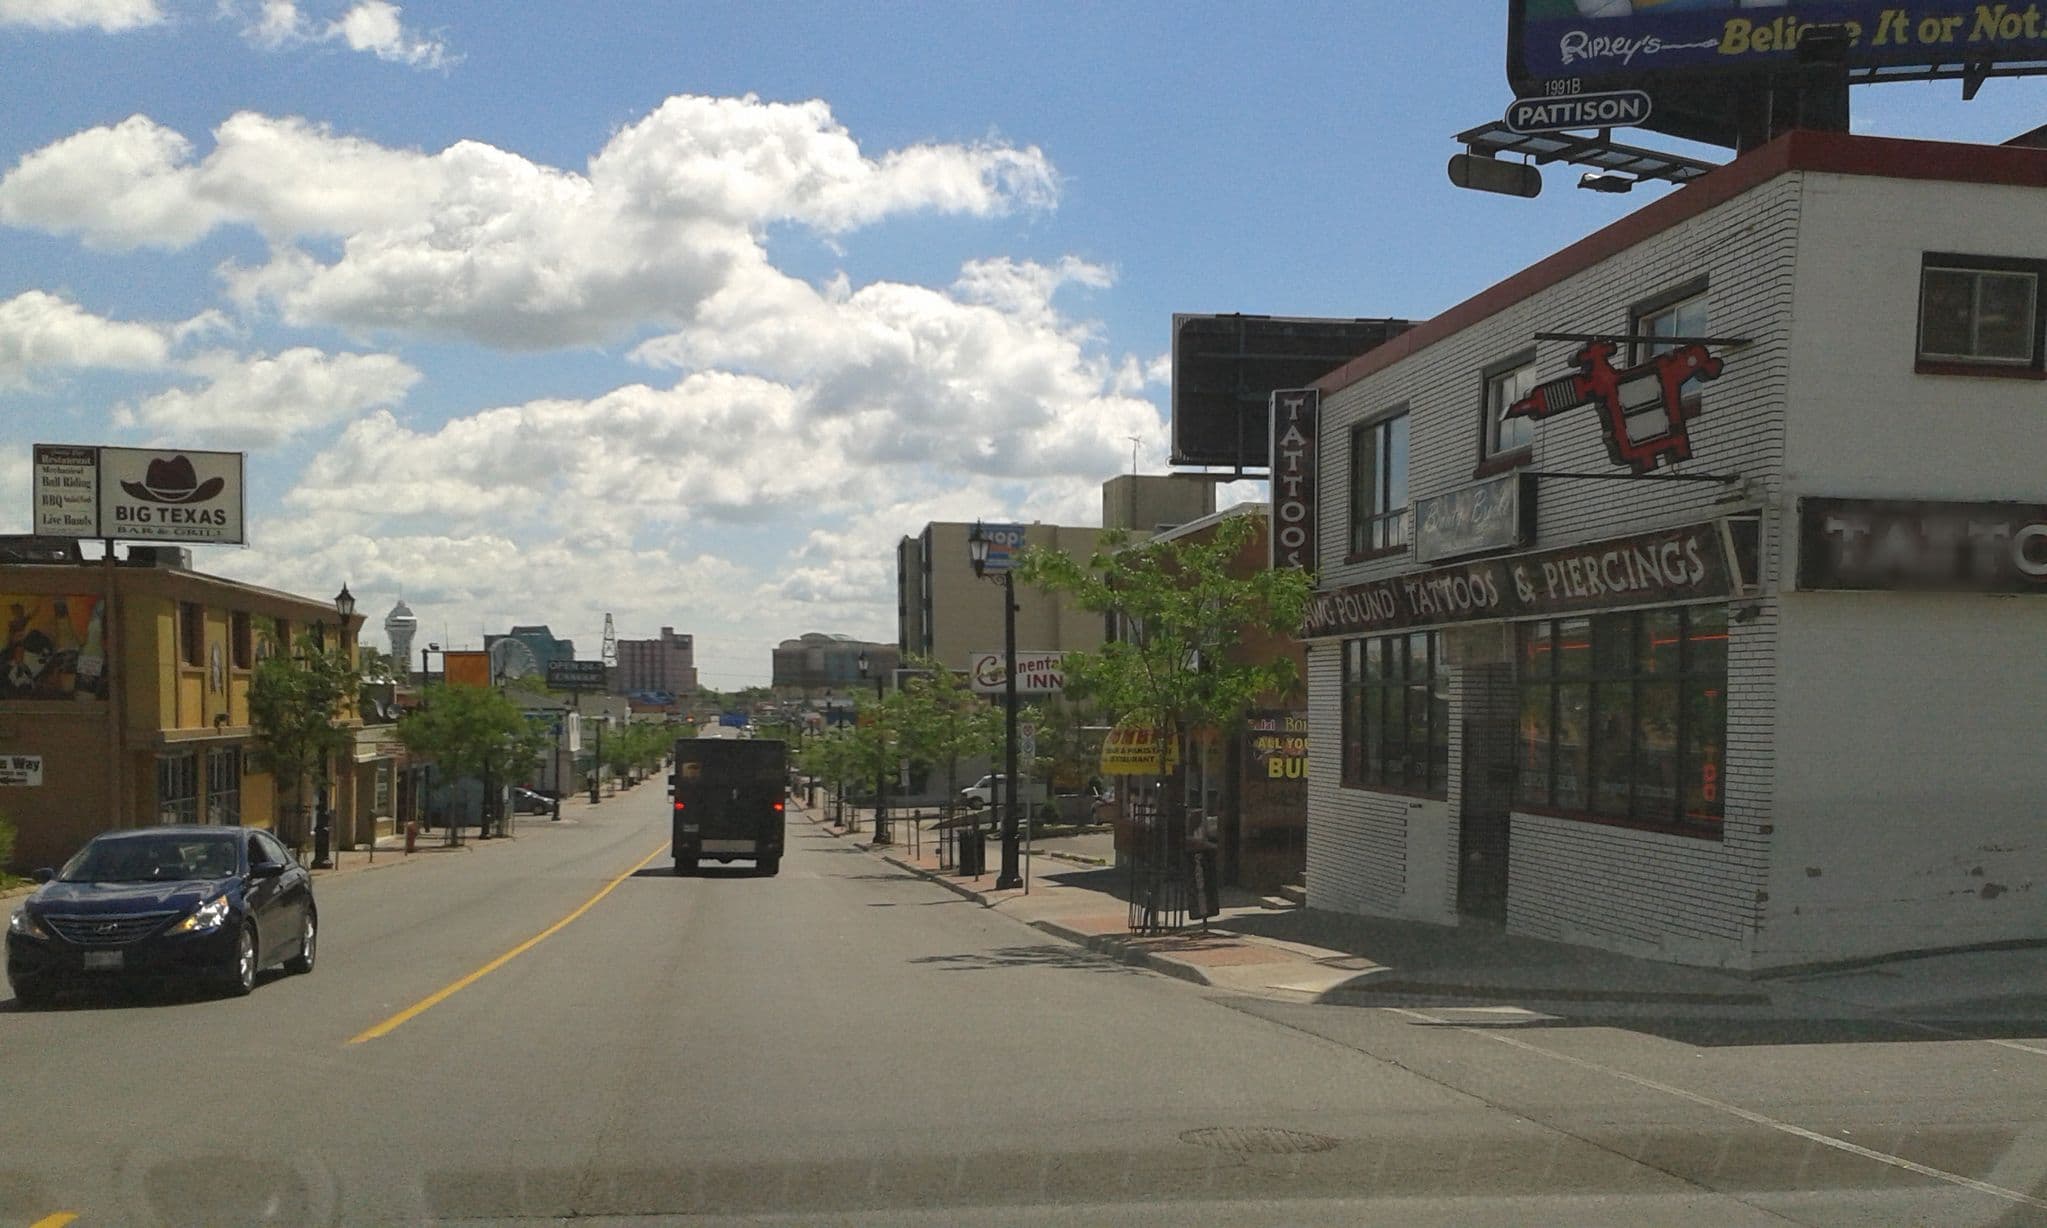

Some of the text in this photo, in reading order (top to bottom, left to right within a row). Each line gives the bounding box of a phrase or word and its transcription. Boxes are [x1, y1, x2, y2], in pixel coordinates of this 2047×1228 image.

[1718, 16, 1863, 55] Belie
[1872, 9, 1911, 46] It
[1917, 16, 1964, 45] or
[1544, 78, 1581, 96] 1991B
[1517, 99, 1640, 127] PATTISON
[1280, 398, 1307, 571] TATTOOS
[42, 495, 63, 508] BBQ
[115, 506, 226, 525] BIG TEXAS
[117, 526, 154, 534] BAR
[1299, 535, 1705, 630] AWG POUND TATTOOS & PIERCINGS
[1025, 674, 1065, 689] INN
[12, 757, 40, 772] Way
